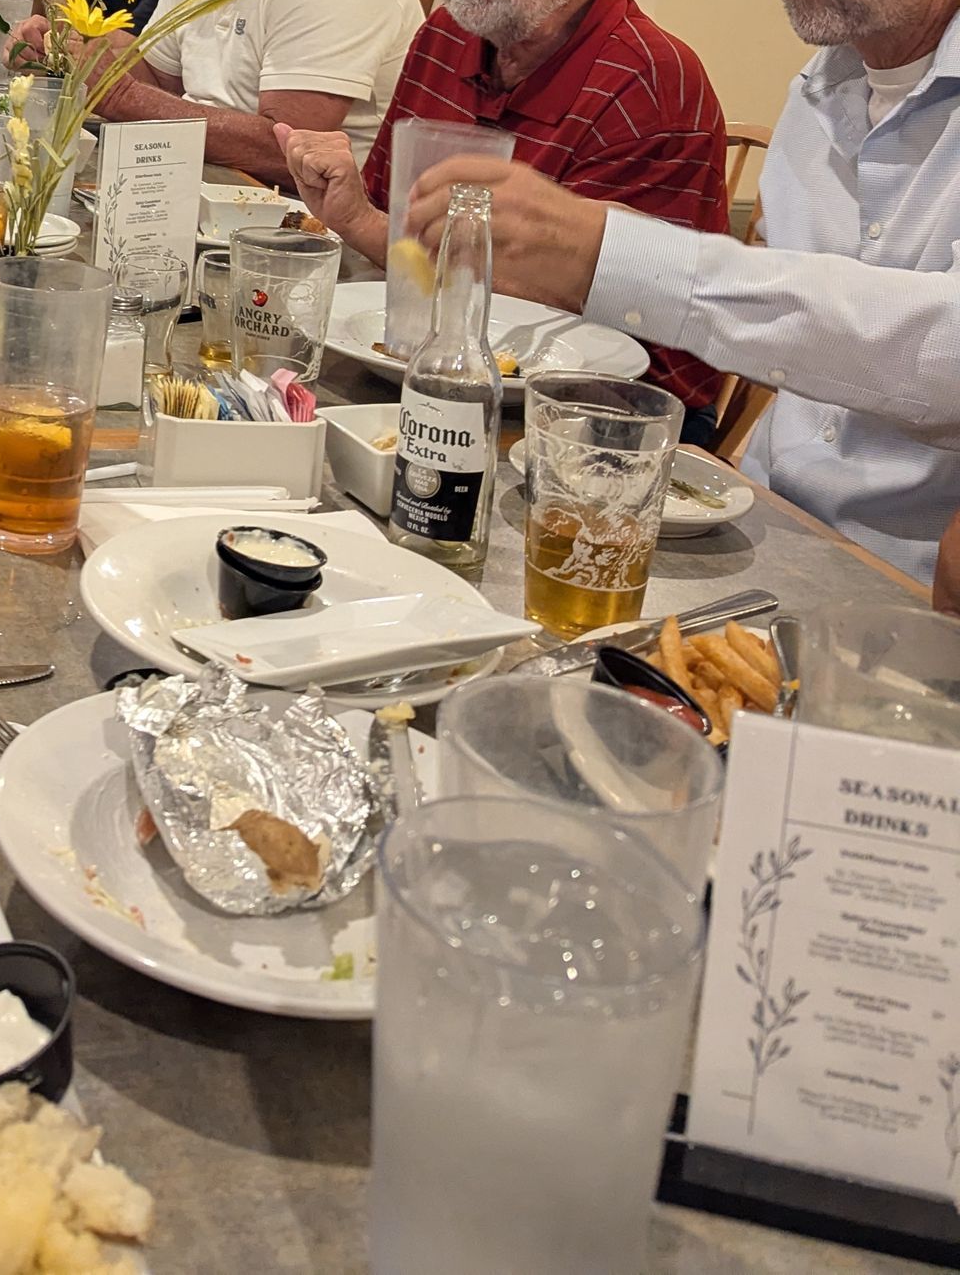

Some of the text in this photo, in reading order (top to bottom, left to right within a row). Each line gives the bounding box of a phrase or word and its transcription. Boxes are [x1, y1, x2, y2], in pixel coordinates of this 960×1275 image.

[134, 141, 172, 151] SEASONAL
[135, 155, 162, 164] DRINKS
[234, 314, 290, 337] ORCHARD
[238, 305, 282, 325] ANGRY
[399, 406, 471, 448] Corona
[404, 435, 447, 463] Extra
[844, 808, 929, 838] DRINKS
